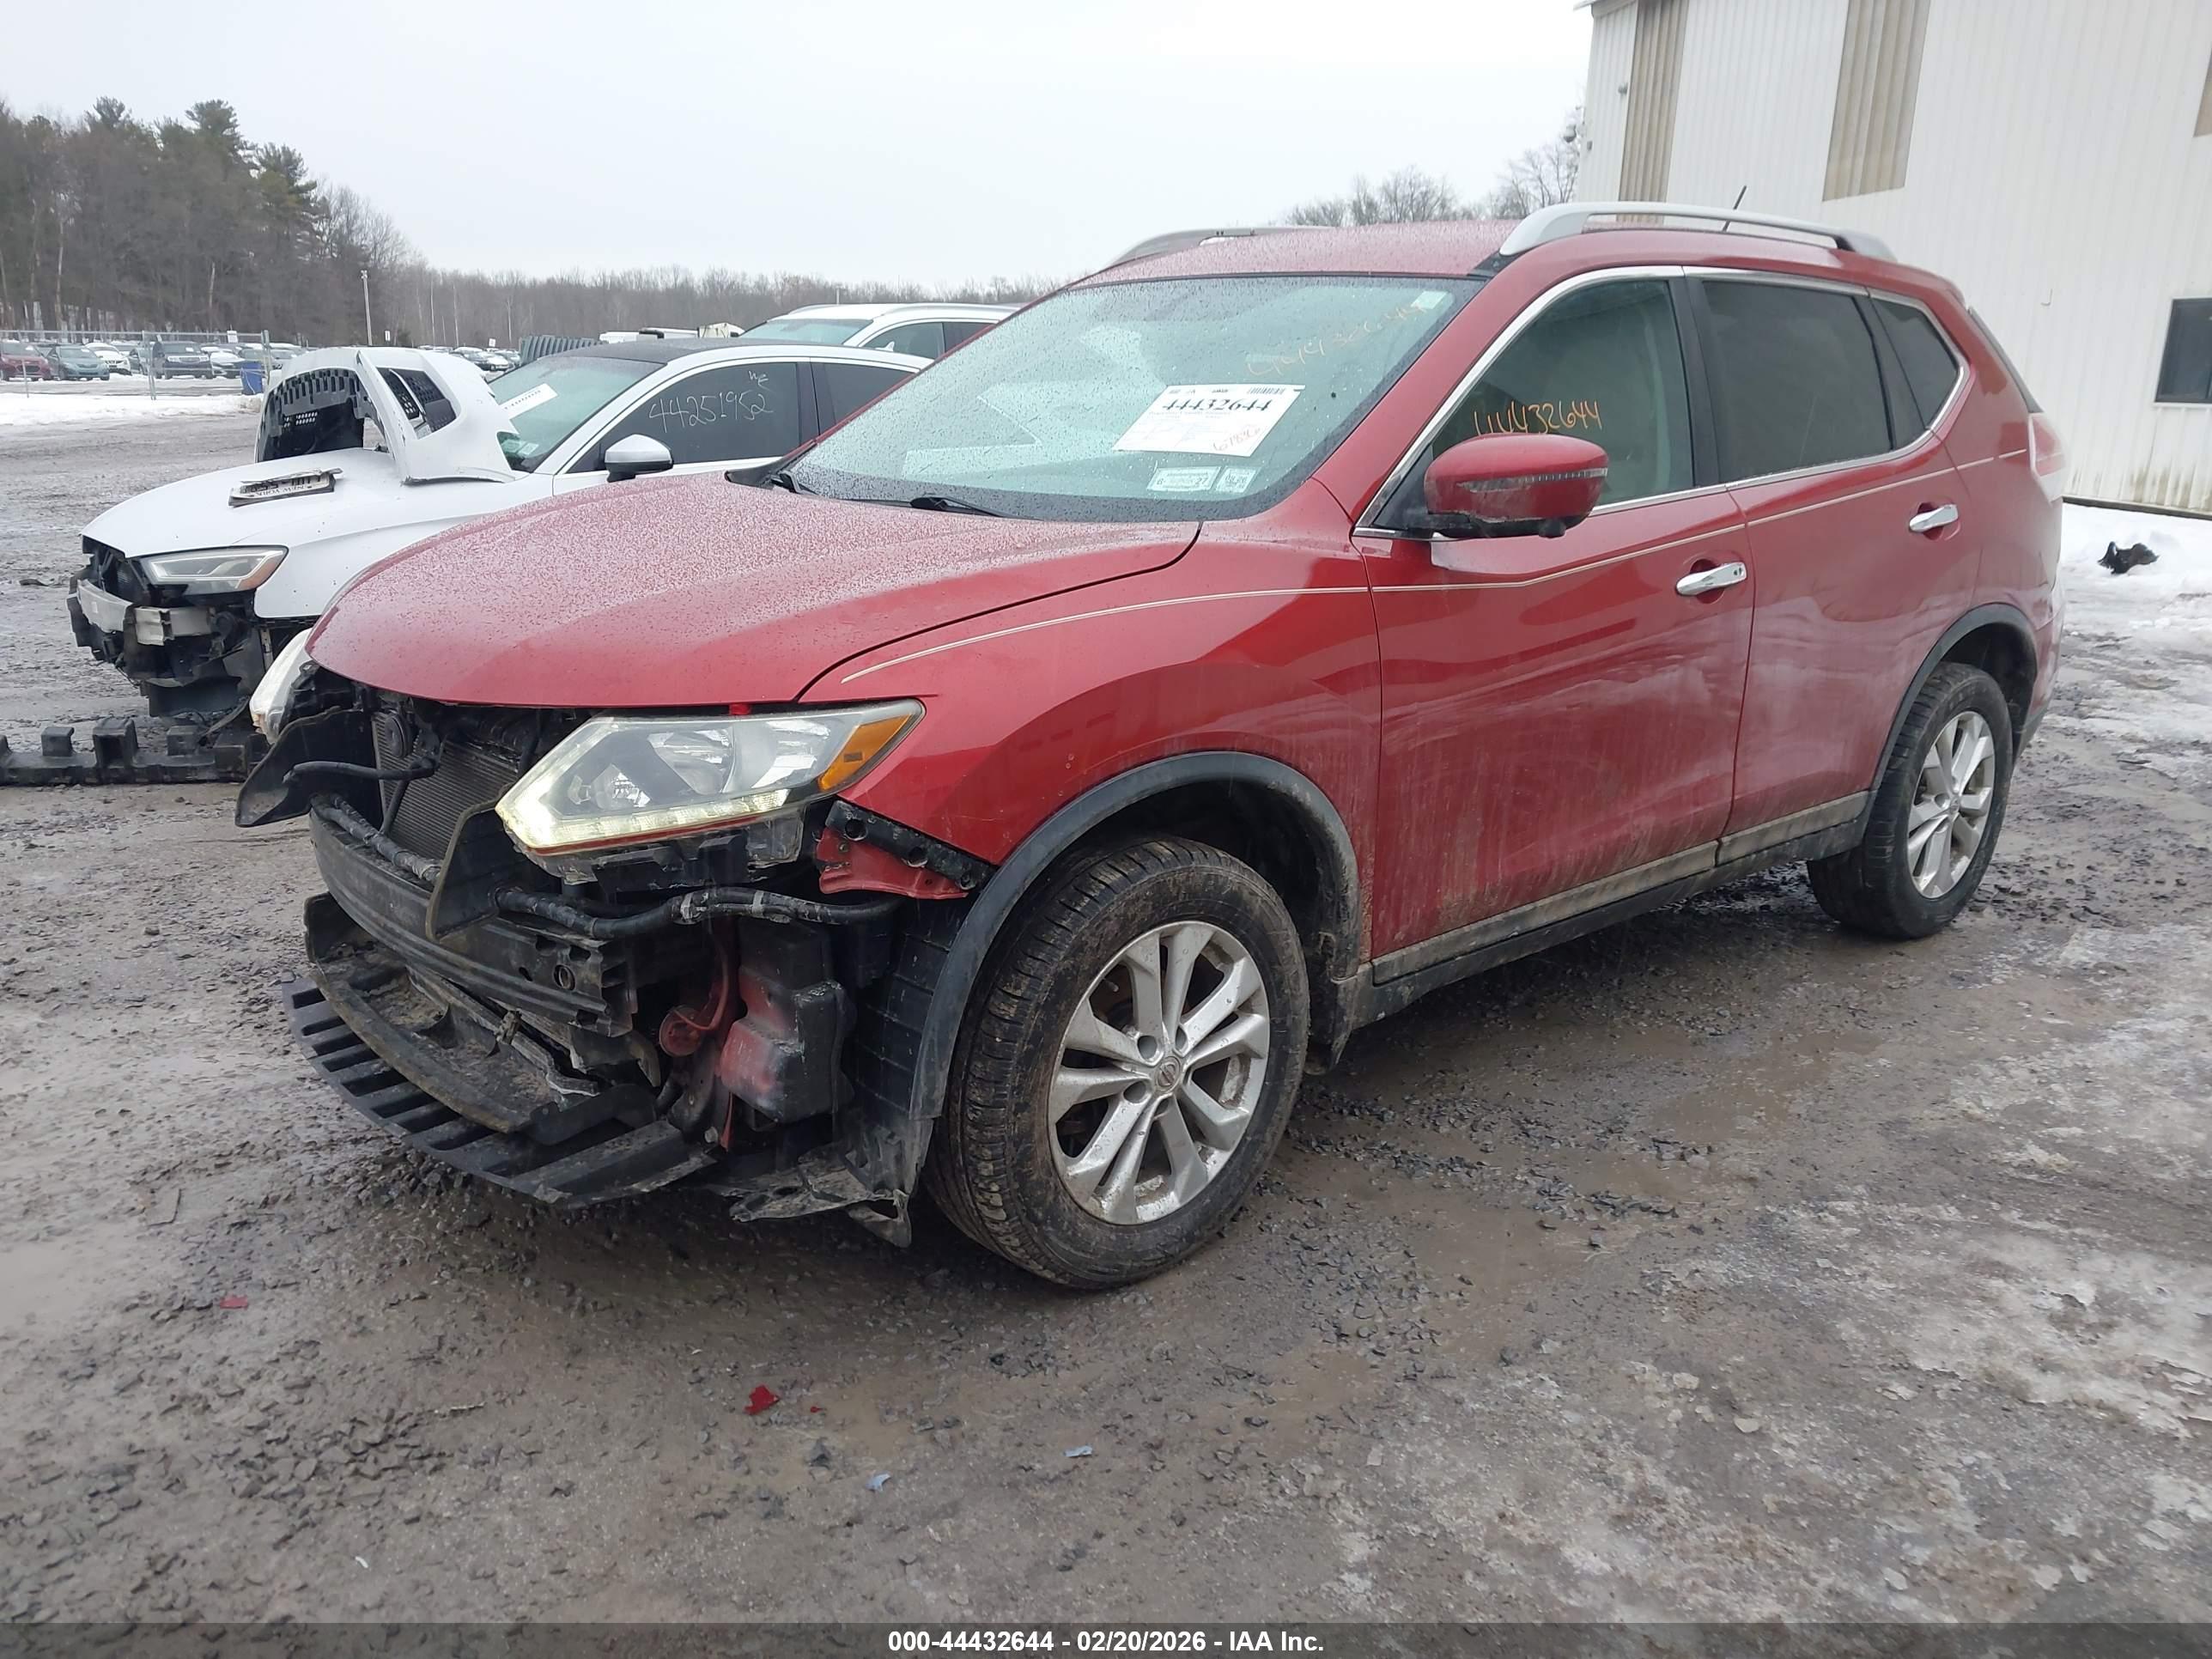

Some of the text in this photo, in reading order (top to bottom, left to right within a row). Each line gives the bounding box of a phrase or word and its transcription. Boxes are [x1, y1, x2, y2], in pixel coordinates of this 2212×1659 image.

[1163, 398, 1273, 411] 44432644
[648, 390, 775, 434] 44251952
[256, 484, 305, 497] NEW YORK
